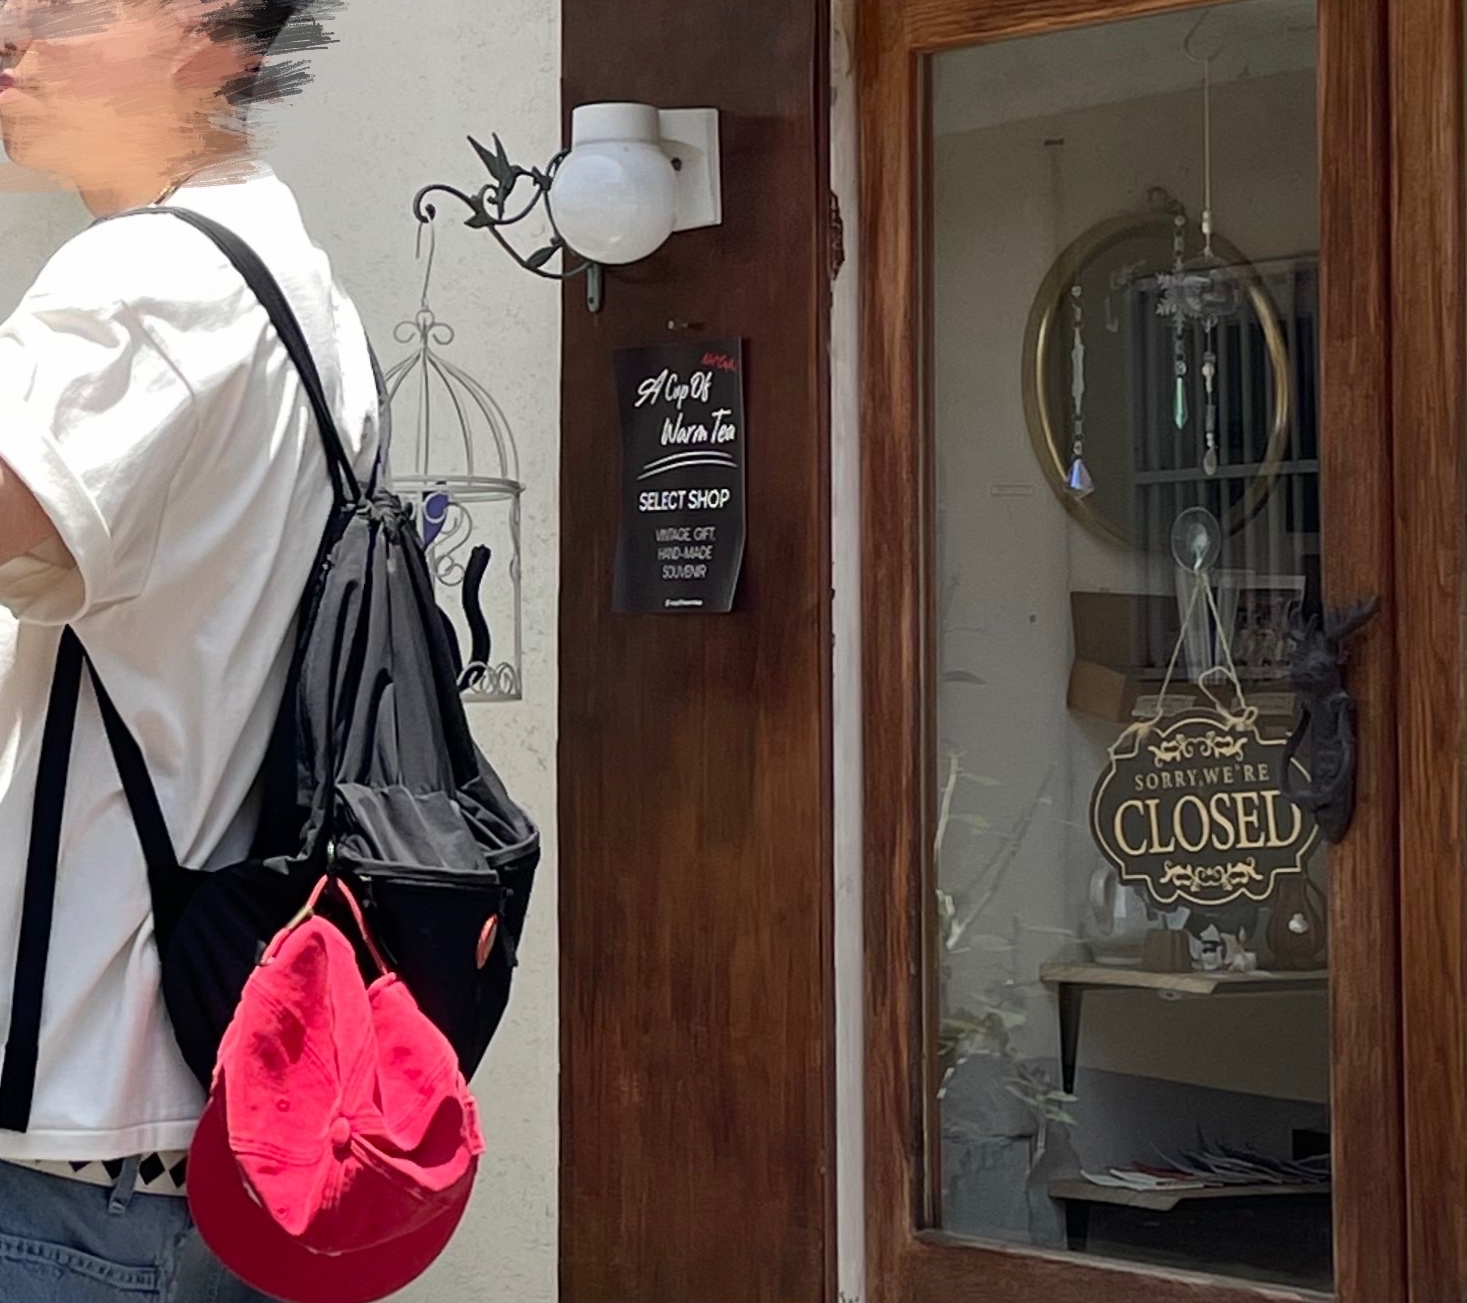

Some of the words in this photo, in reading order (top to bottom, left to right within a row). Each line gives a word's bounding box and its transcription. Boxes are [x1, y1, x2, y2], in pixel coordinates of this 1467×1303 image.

[665, 372, 689, 410] Cup
[660, 412, 708, 446] Warm
[711, 408, 736, 444] Tea
[638, 490, 687, 512] SELECT
[687, 488, 731, 510] SHOP
[655, 527, 691, 542] VINTAGE
[662, 564, 707, 580] SOUVENIR
[1113, 790, 1301, 855] CLOSED
